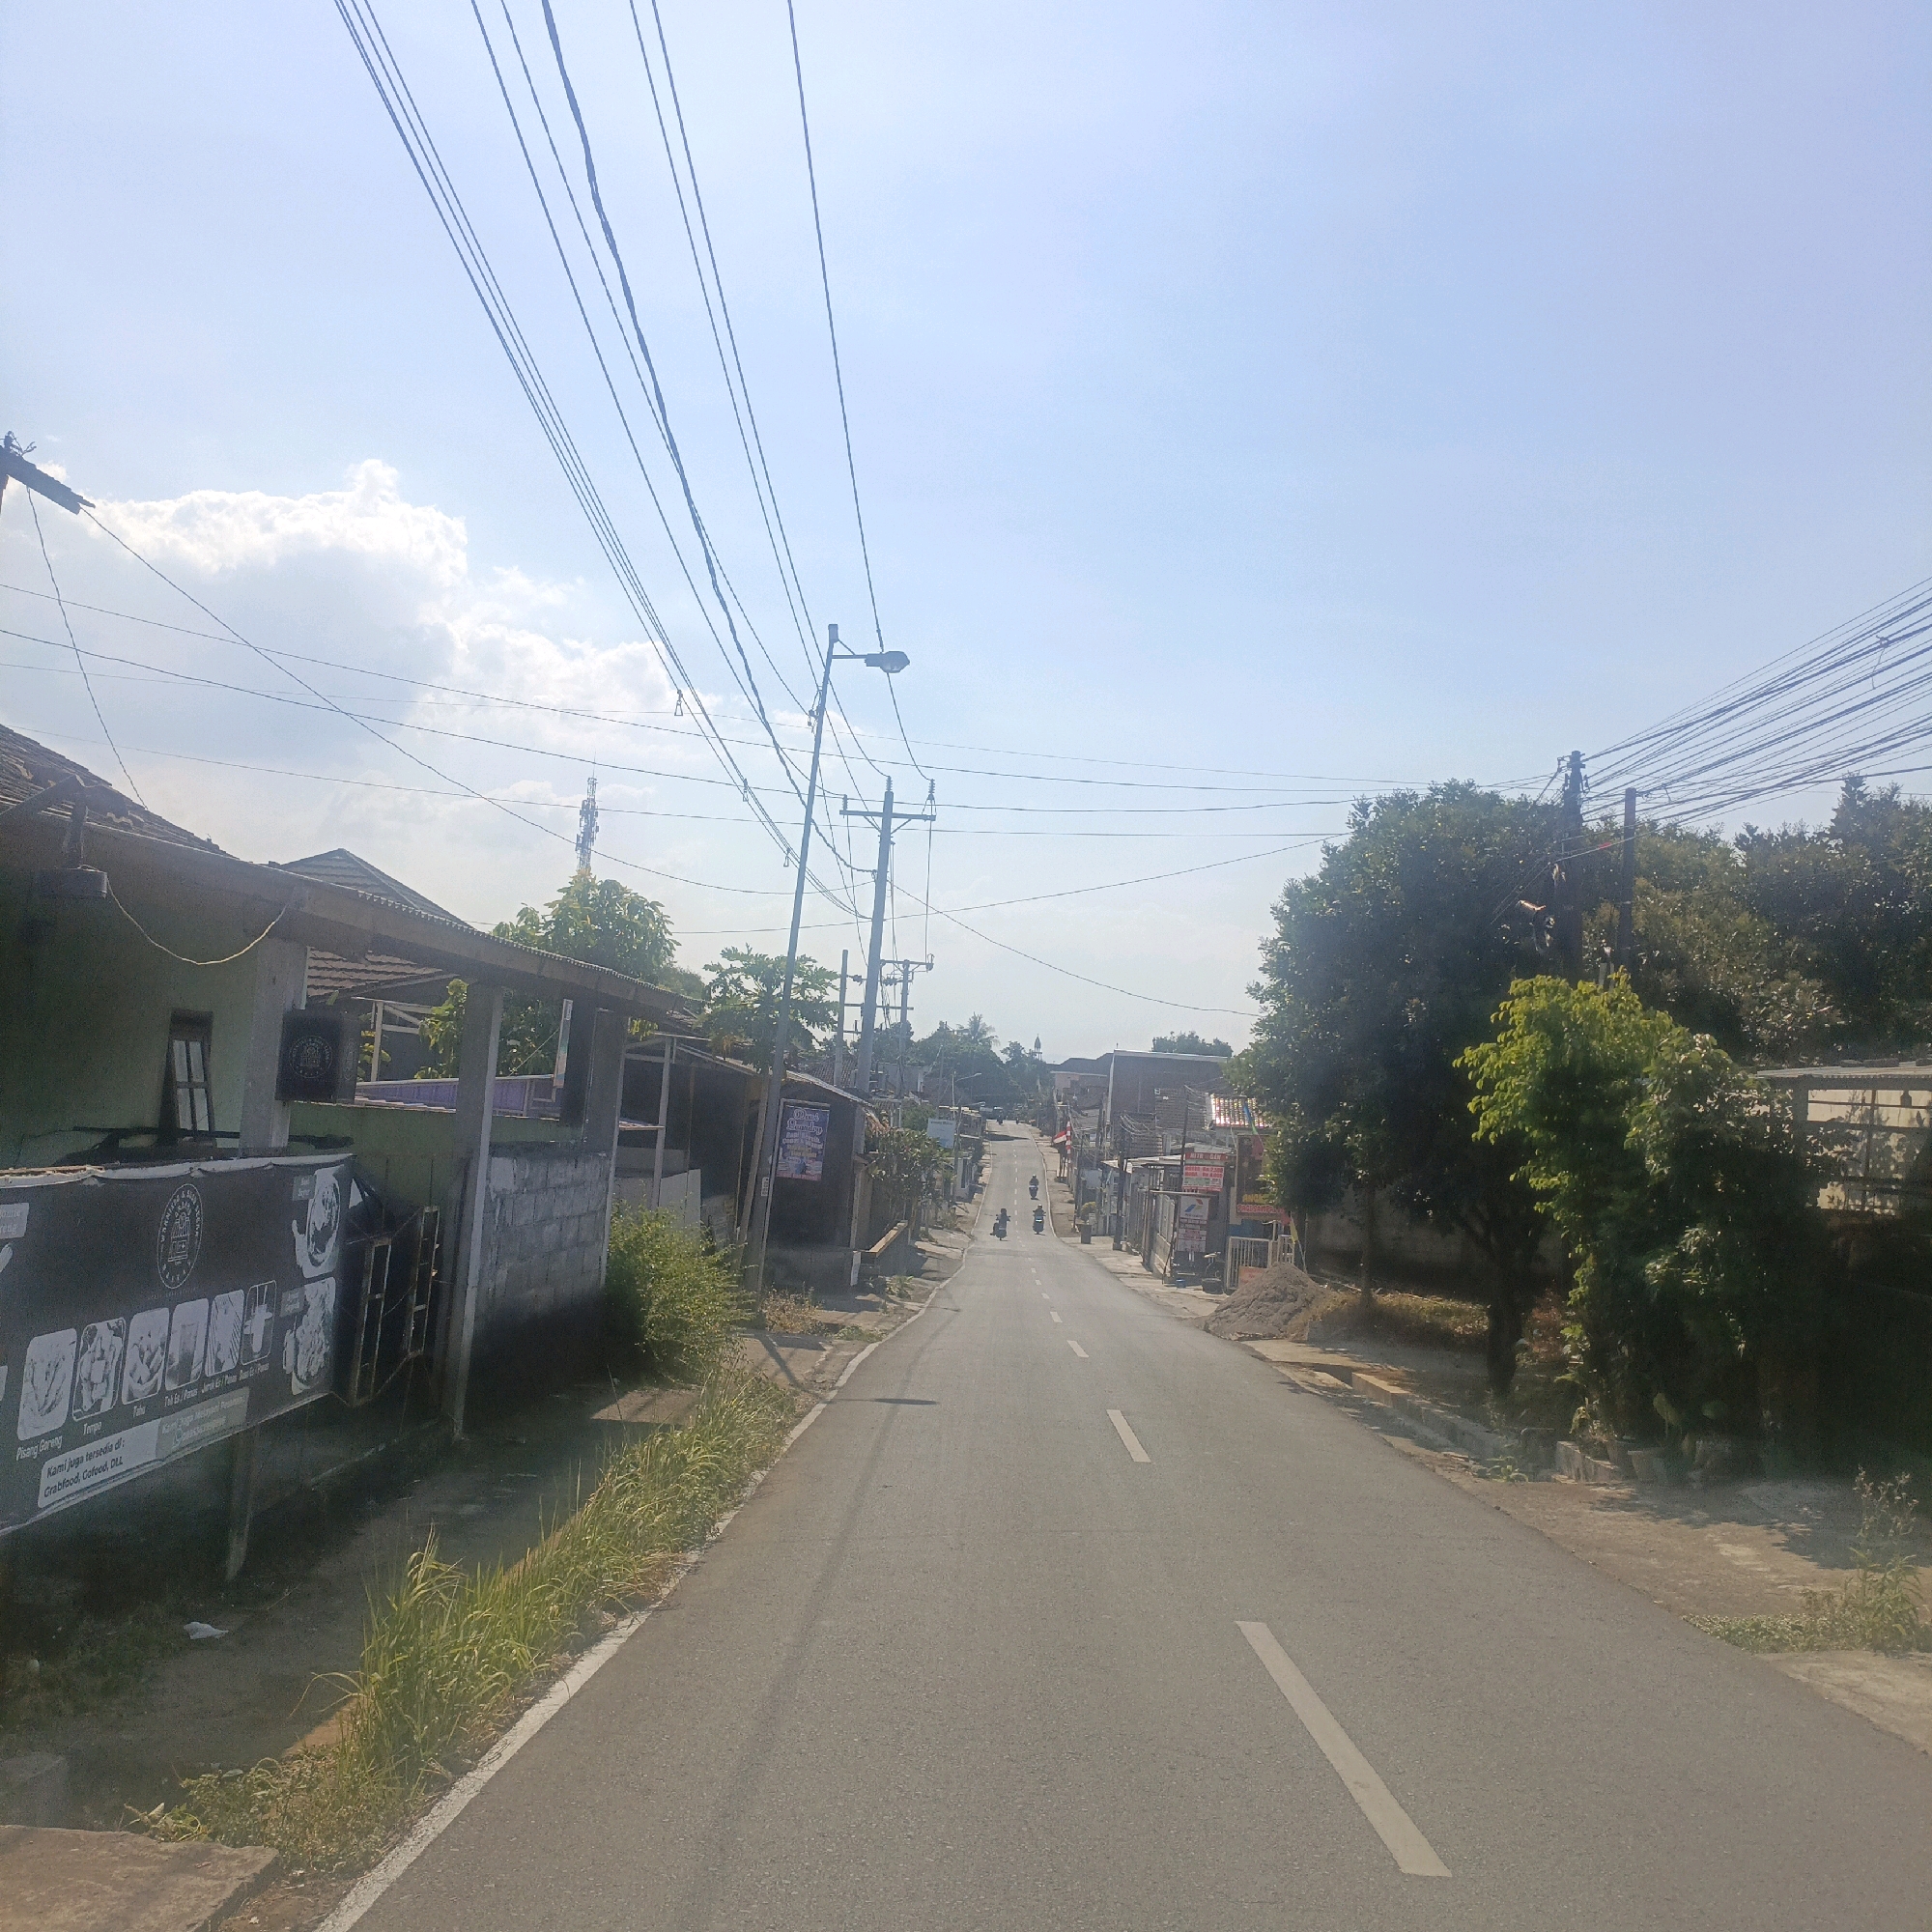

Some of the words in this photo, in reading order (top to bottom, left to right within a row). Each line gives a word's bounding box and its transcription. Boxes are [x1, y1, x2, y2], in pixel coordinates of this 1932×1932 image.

[15, 1444, 40, 1462] Pisang
[39, 1435, 64, 1453] Goreng
[46, 1463, 67, 1479] Kami
[67, 1455, 84, 1474] juga
[85, 1443, 113, 1462] tersedia
[43, 1473, 81, 1498] Grabfood,
[110, 1456, 124, 1468] DLL
